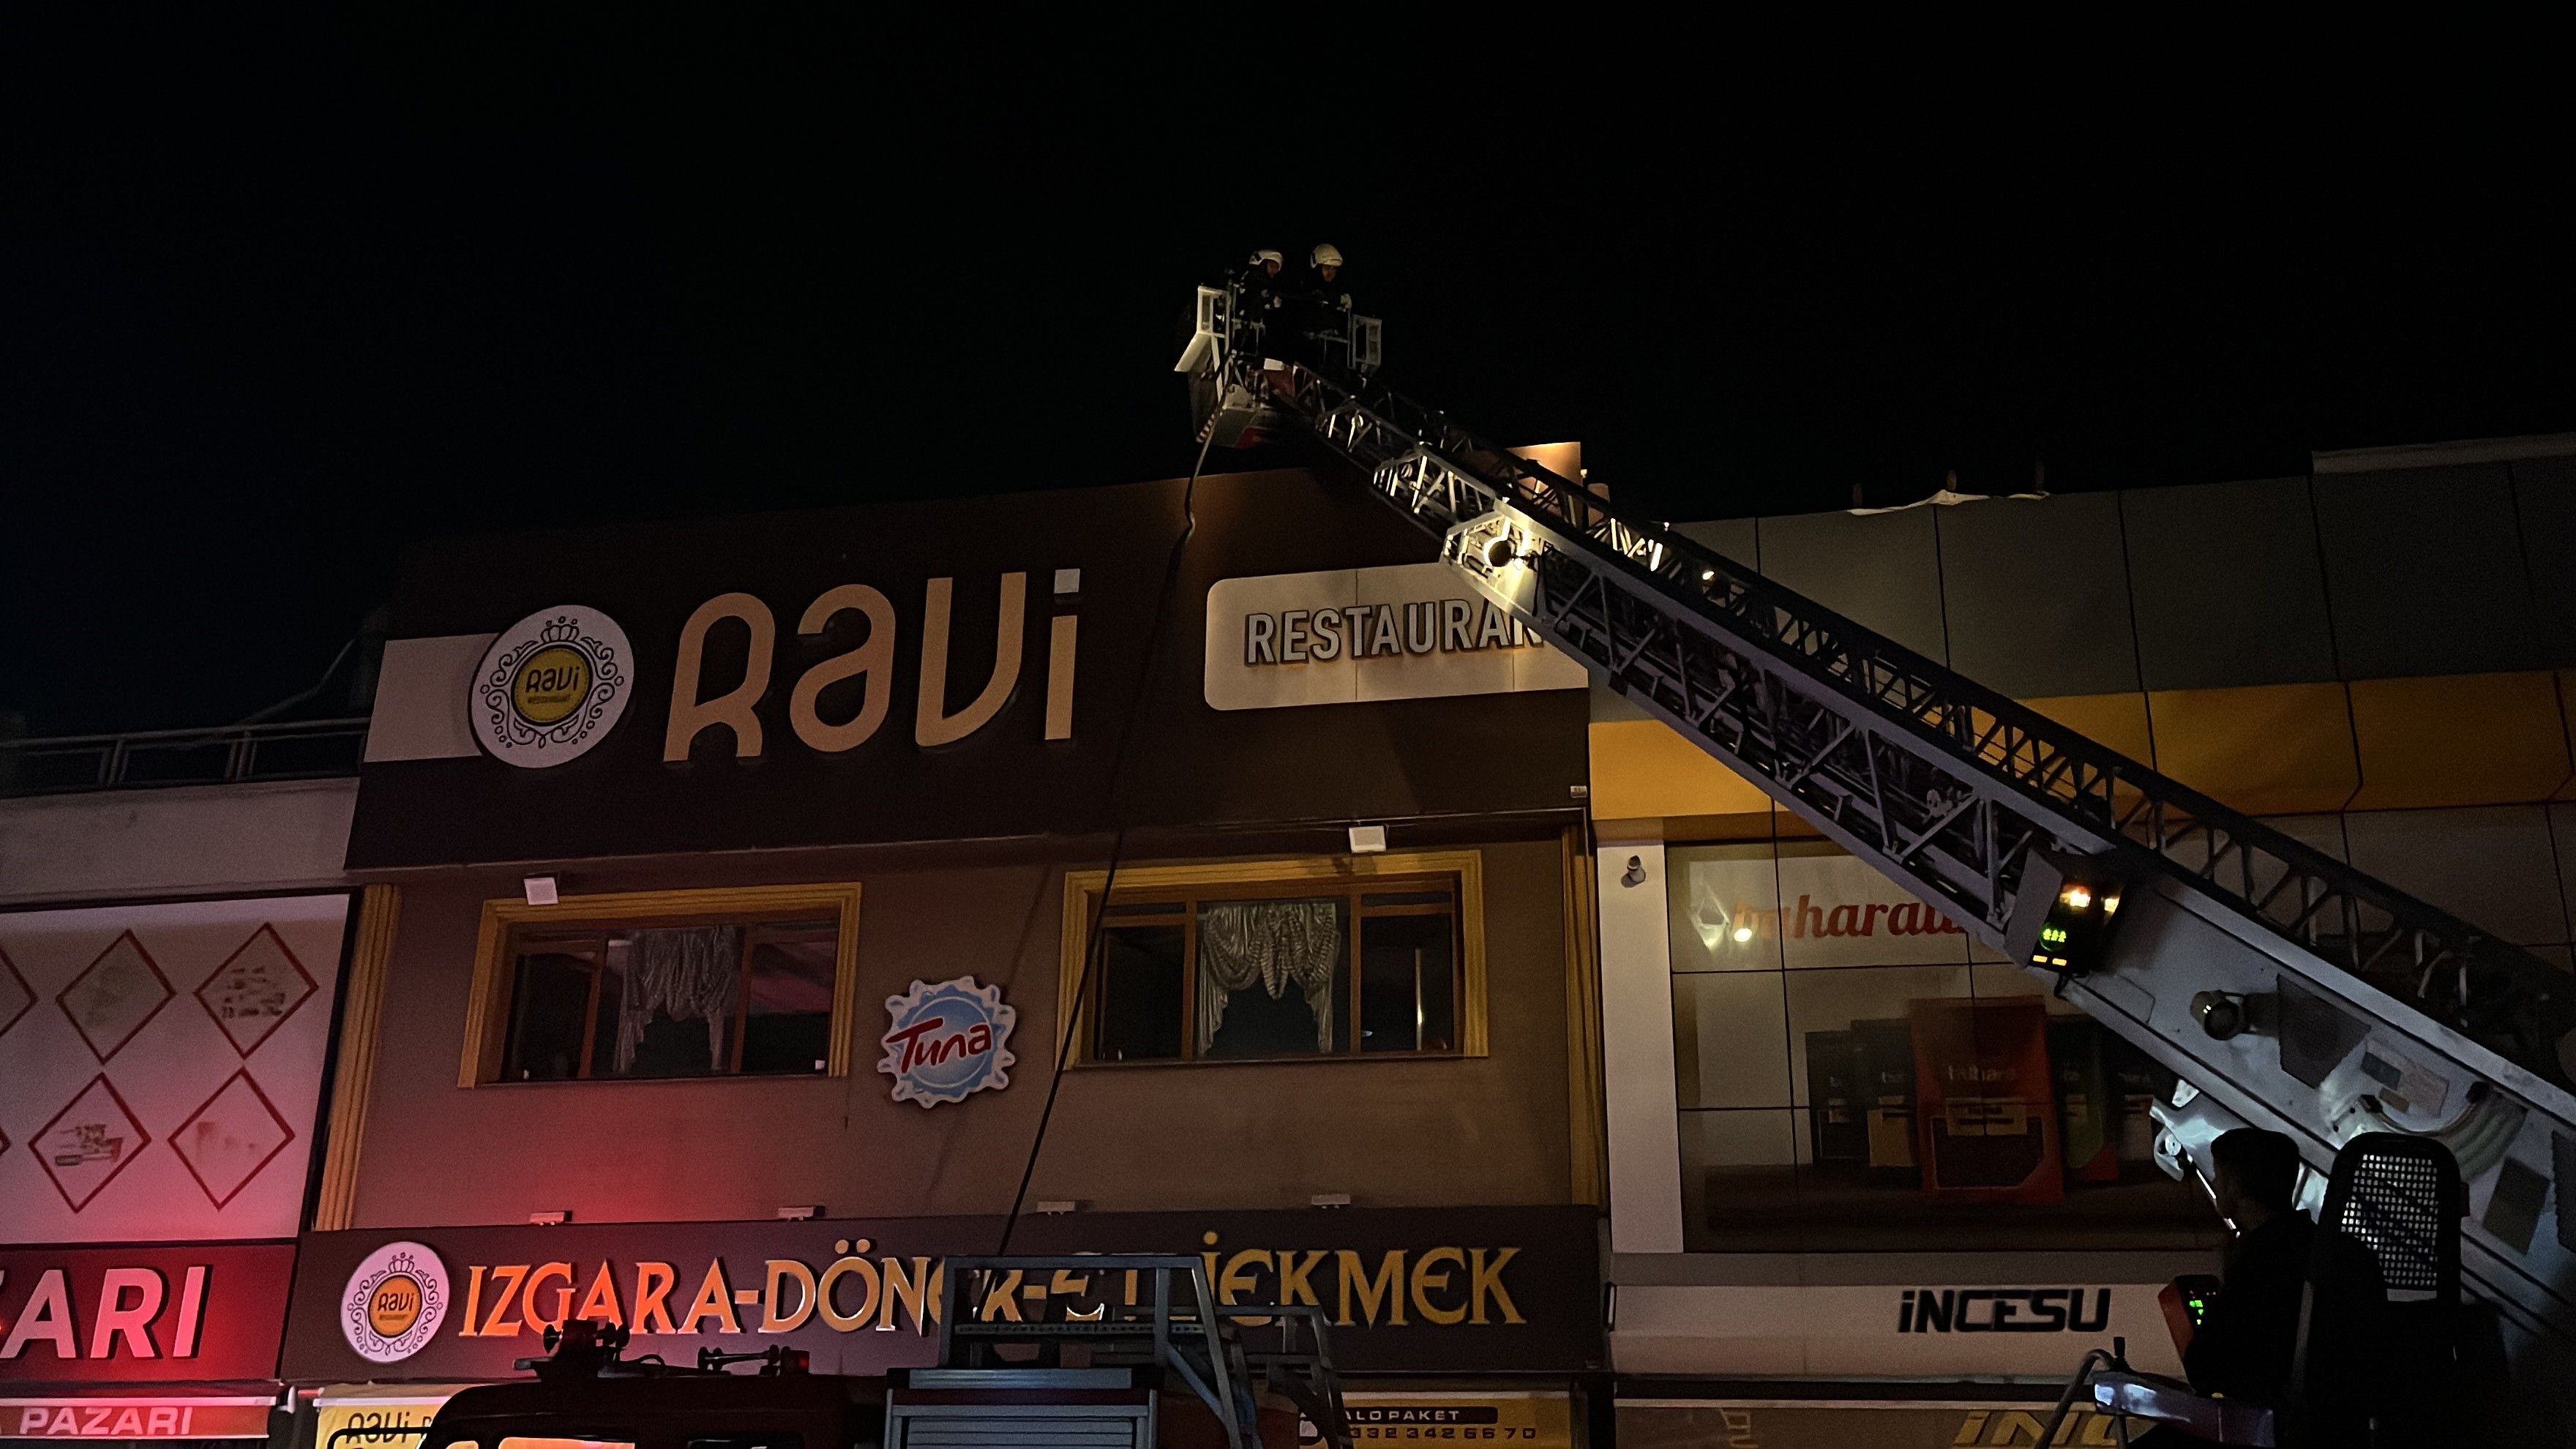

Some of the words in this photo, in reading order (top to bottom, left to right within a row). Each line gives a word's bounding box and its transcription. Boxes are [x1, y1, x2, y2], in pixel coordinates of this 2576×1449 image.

[1246, 598, 1544, 664] RESTAURAN
[886, 1017, 992, 1074] Tuna
[0, 1265, 206, 1359] ARI
[19, 1407, 193, 1435] PAZARI
[1388, 1409, 1460, 1421] PAKET
[1505, 1428, 1536, 1439] 70
